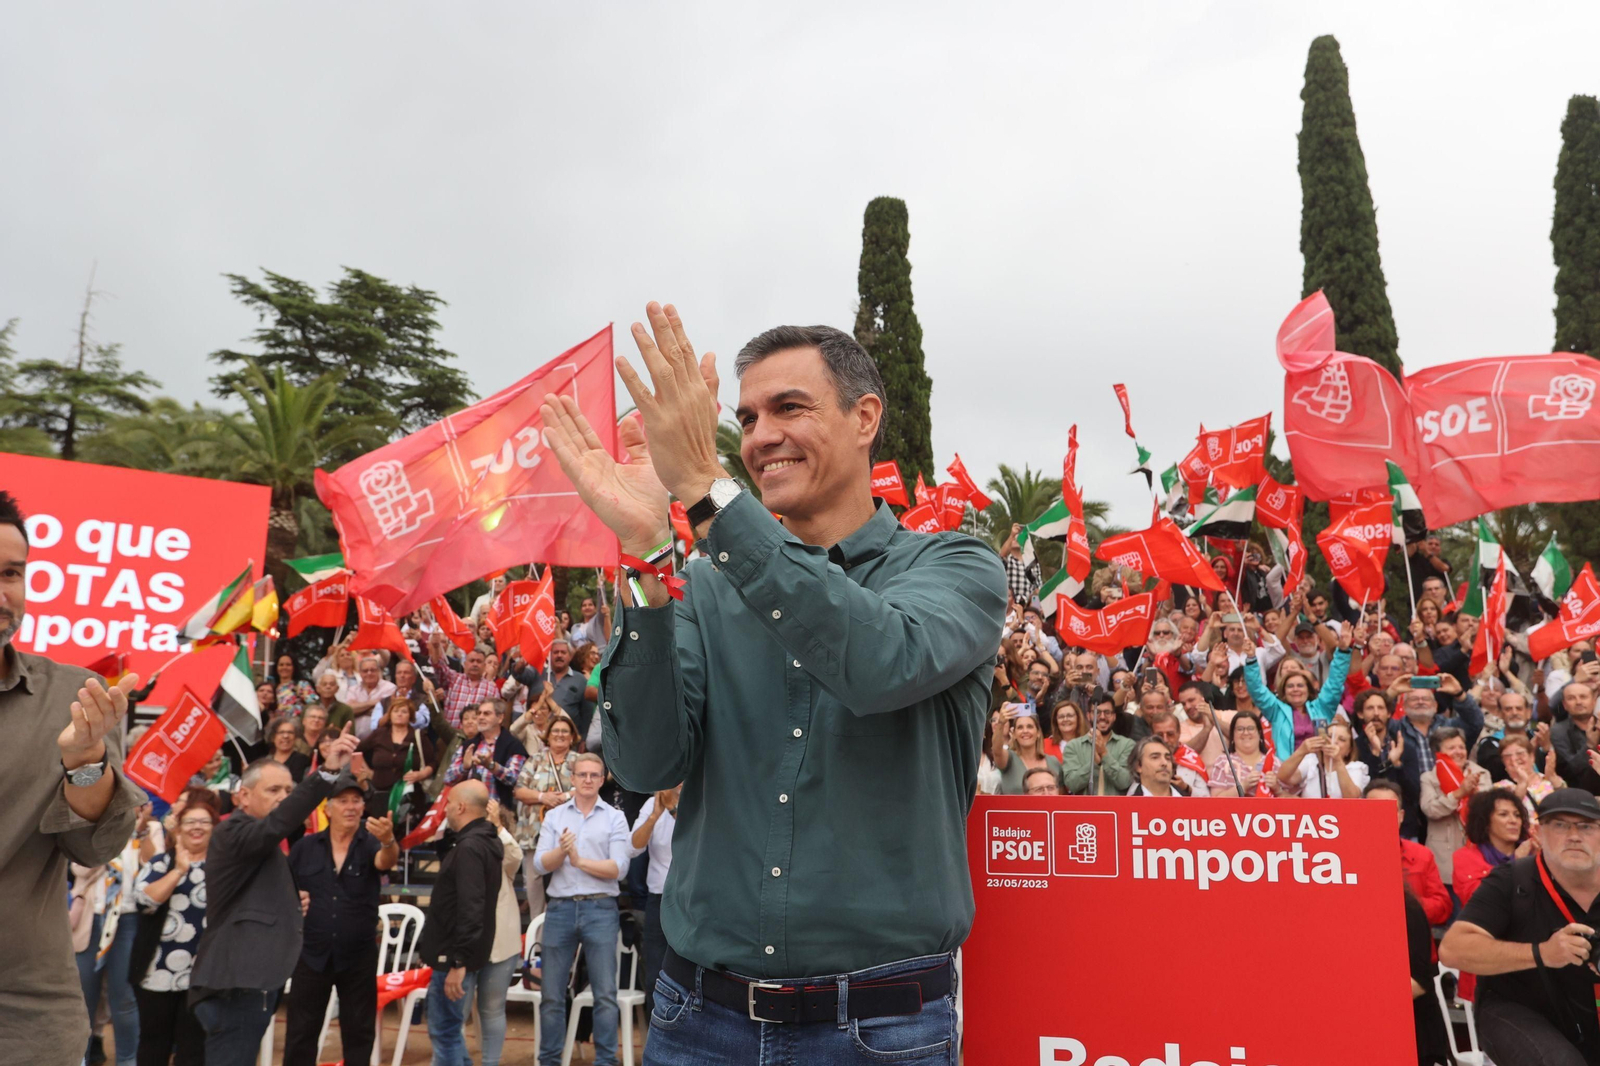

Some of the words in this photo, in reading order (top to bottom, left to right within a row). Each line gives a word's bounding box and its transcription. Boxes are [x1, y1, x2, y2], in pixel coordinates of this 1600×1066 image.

[25, 514, 63, 549] o
[75, 519, 191, 564] que
[25, 560, 185, 613] OTAS
[992, 826, 1031, 840] Badajoz
[1131, 812, 1167, 836] Lo
[1172, 818, 1227, 841] que
[1231, 813, 1340, 839] VOTAS
[991, 840, 1045, 861] PSOE
[1132, 837, 1358, 890] importa.
[986, 878, 1049, 889] 23/05/2023
